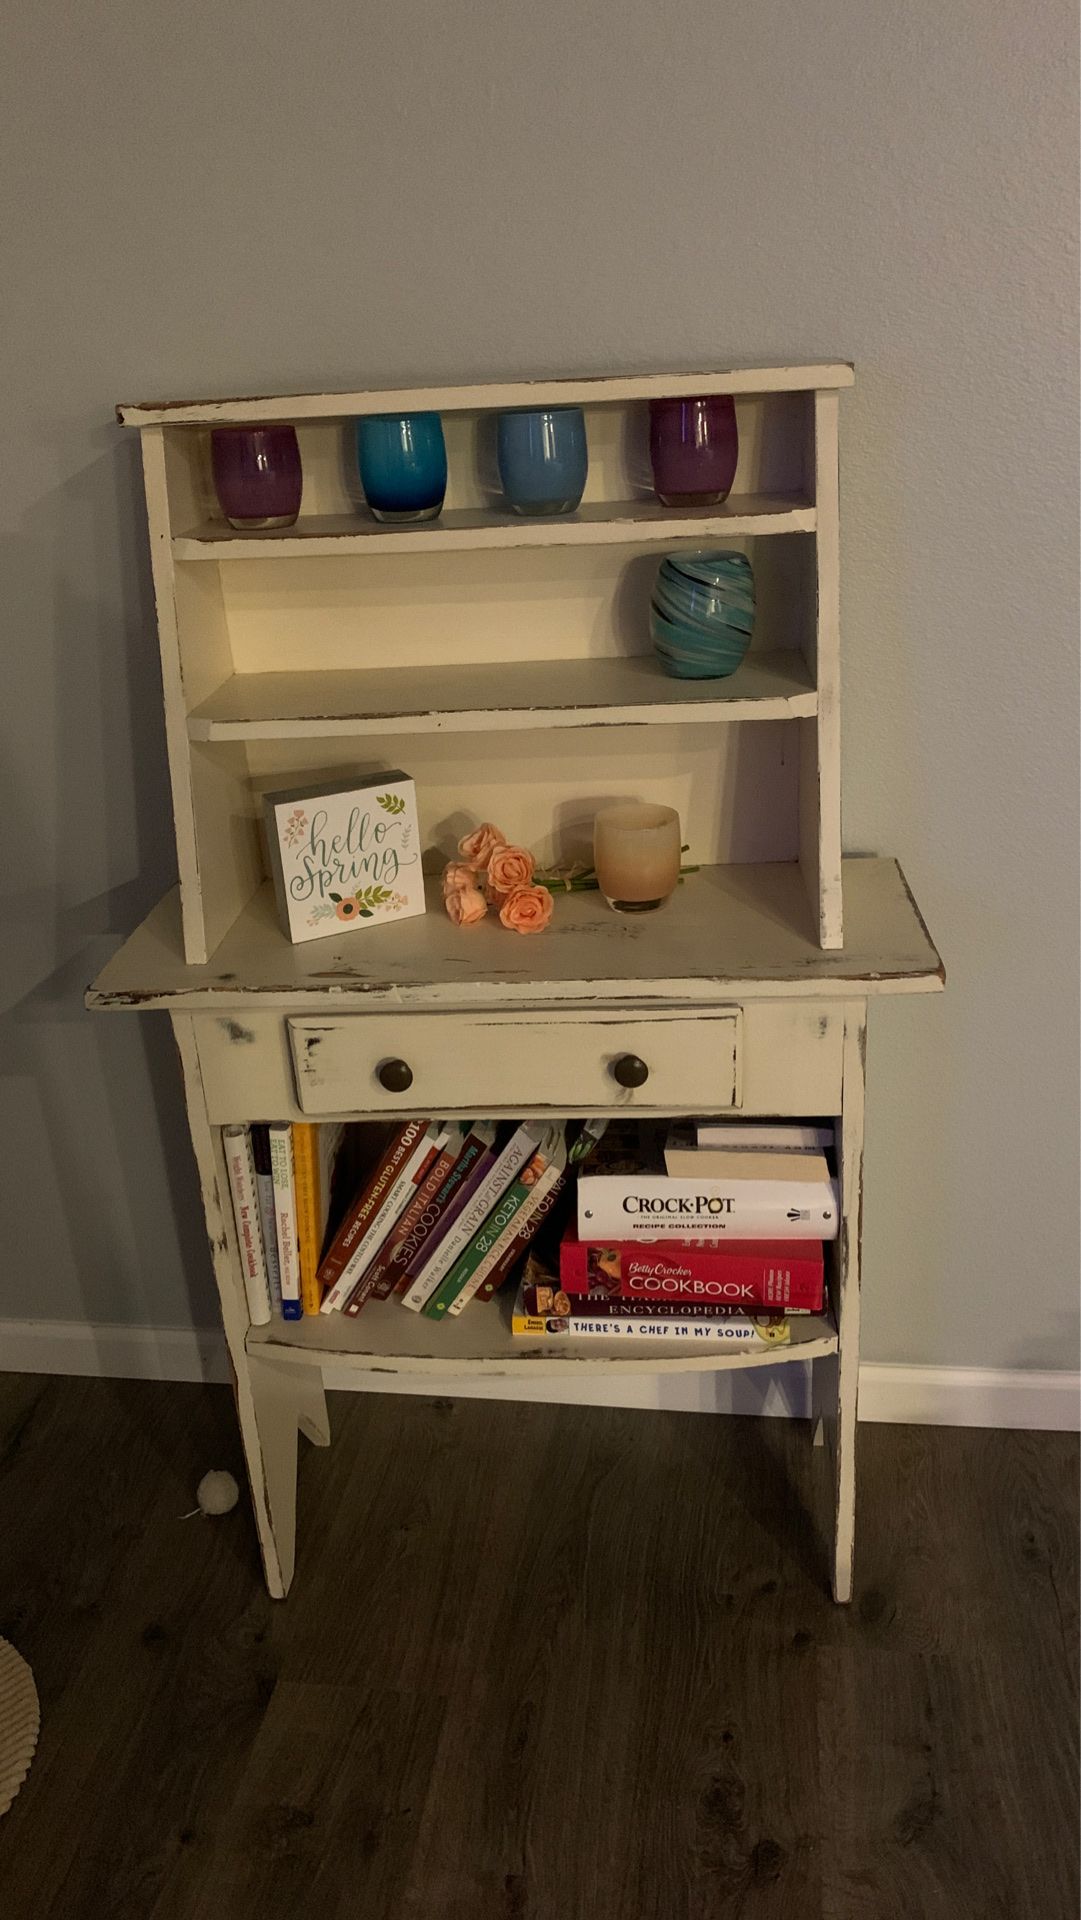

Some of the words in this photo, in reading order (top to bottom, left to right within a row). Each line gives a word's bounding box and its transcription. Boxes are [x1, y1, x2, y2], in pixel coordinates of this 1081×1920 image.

[296, 807, 401, 867] hello
[400, 1122, 420, 1146] 100
[271, 1139, 279, 1153] EAT
[278, 1140, 286, 1153] EAT
[391, 1146, 406, 1166] BEST
[272, 1155, 279, 1166] TO
[280, 1155, 287, 1167] TO
[456, 1145, 479, 1173] Martha
[273, 1167, 281, 1185] WIN
[425, 1160, 450, 1192] BOLD
[488, 1147, 523, 1198] AGAINST
[357, 1165, 395, 1220] GLUTEN-FREE
[390, 1180, 406, 1201] SMART
[240, 1205, 249, 1219] New
[373, 1199, 395, 1229] COOKING
[398, 1192, 431, 1236] ITALIAN
[461, 1200, 490, 1236] GRAIN
[494, 1195, 520, 1226] KETO
[532, 1210, 545, 1226] IN
[242, 1220, 253, 1249] Complete
[280, 1212, 290, 1240] Rachel
[342, 1220, 362, 1248] RECIPES
[365, 1227, 378, 1242] THE
[393, 1203, 441, 1266] COOKIES
[485, 1223, 501, 1239] IN
[518, 1222, 535, 1240] 28
[351, 1239, 371, 1266] COSTCO
[439, 1235, 462, 1265] Danielle
[475, 1235, 492, 1253] 28
[247, 1249, 258, 1278] Cookbook
[374, 1264, 386, 1282] Scott
[629, 1262, 653, 1275] Betty
[654, 1263, 692, 1277] Crocker
[422, 1265, 442, 1290] Walker
[629, 1276, 755, 1299] COOKBOOK
[609, 1305, 745, 1315] ENCYCLOPEDIA
[573, 1322, 620, 1333] THERE'S
[626, 1325, 634, 1333] A
[639, 1325, 669, 1335] CHEF
[675, 1326, 689, 1336] IN
[694, 1328, 712, 1337] MY
[717, 1329, 756, 1338] SOUP!
